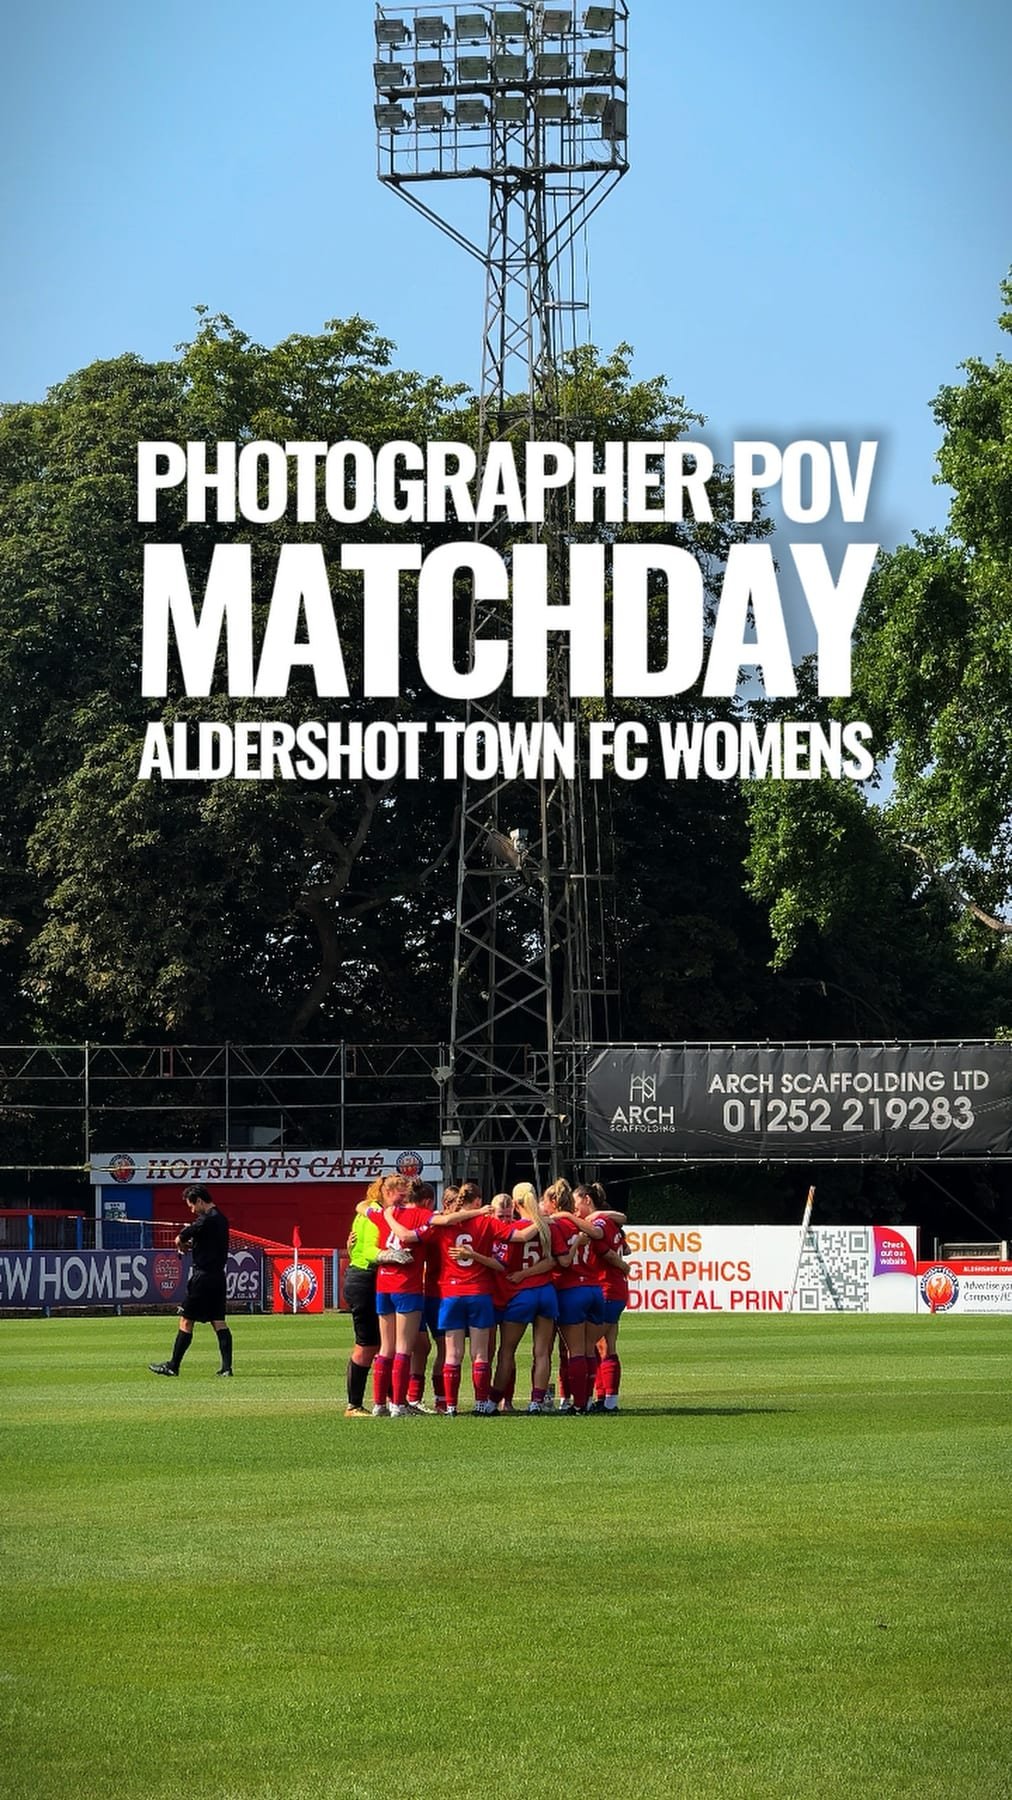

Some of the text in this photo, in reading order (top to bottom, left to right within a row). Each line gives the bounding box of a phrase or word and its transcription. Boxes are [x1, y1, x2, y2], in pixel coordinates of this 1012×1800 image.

[708, 1069, 990, 1095] ARCH SCAFFOLDING LTD
[610, 1105, 675, 1125] ARCH
[723, 1095, 976, 1133] 01252 219283
[609, 1124, 676, 1134] SCAFFOLDING
[146, 1157, 301, 1180] HOTSHOTS
[308, 1152, 385, 1178] CAFÉ
[455, 1233, 475, 1267] 6
[625, 1231, 702, 1252] SIGNS
[881, 1240, 905, 1249] Check
[522, 1241, 541, 1269] 5
[38, 1255, 149, 1301] HOMES
[628, 1260, 752, 1282] GRAPHICS
[626, 1289, 723, 1311] DIGITAL
